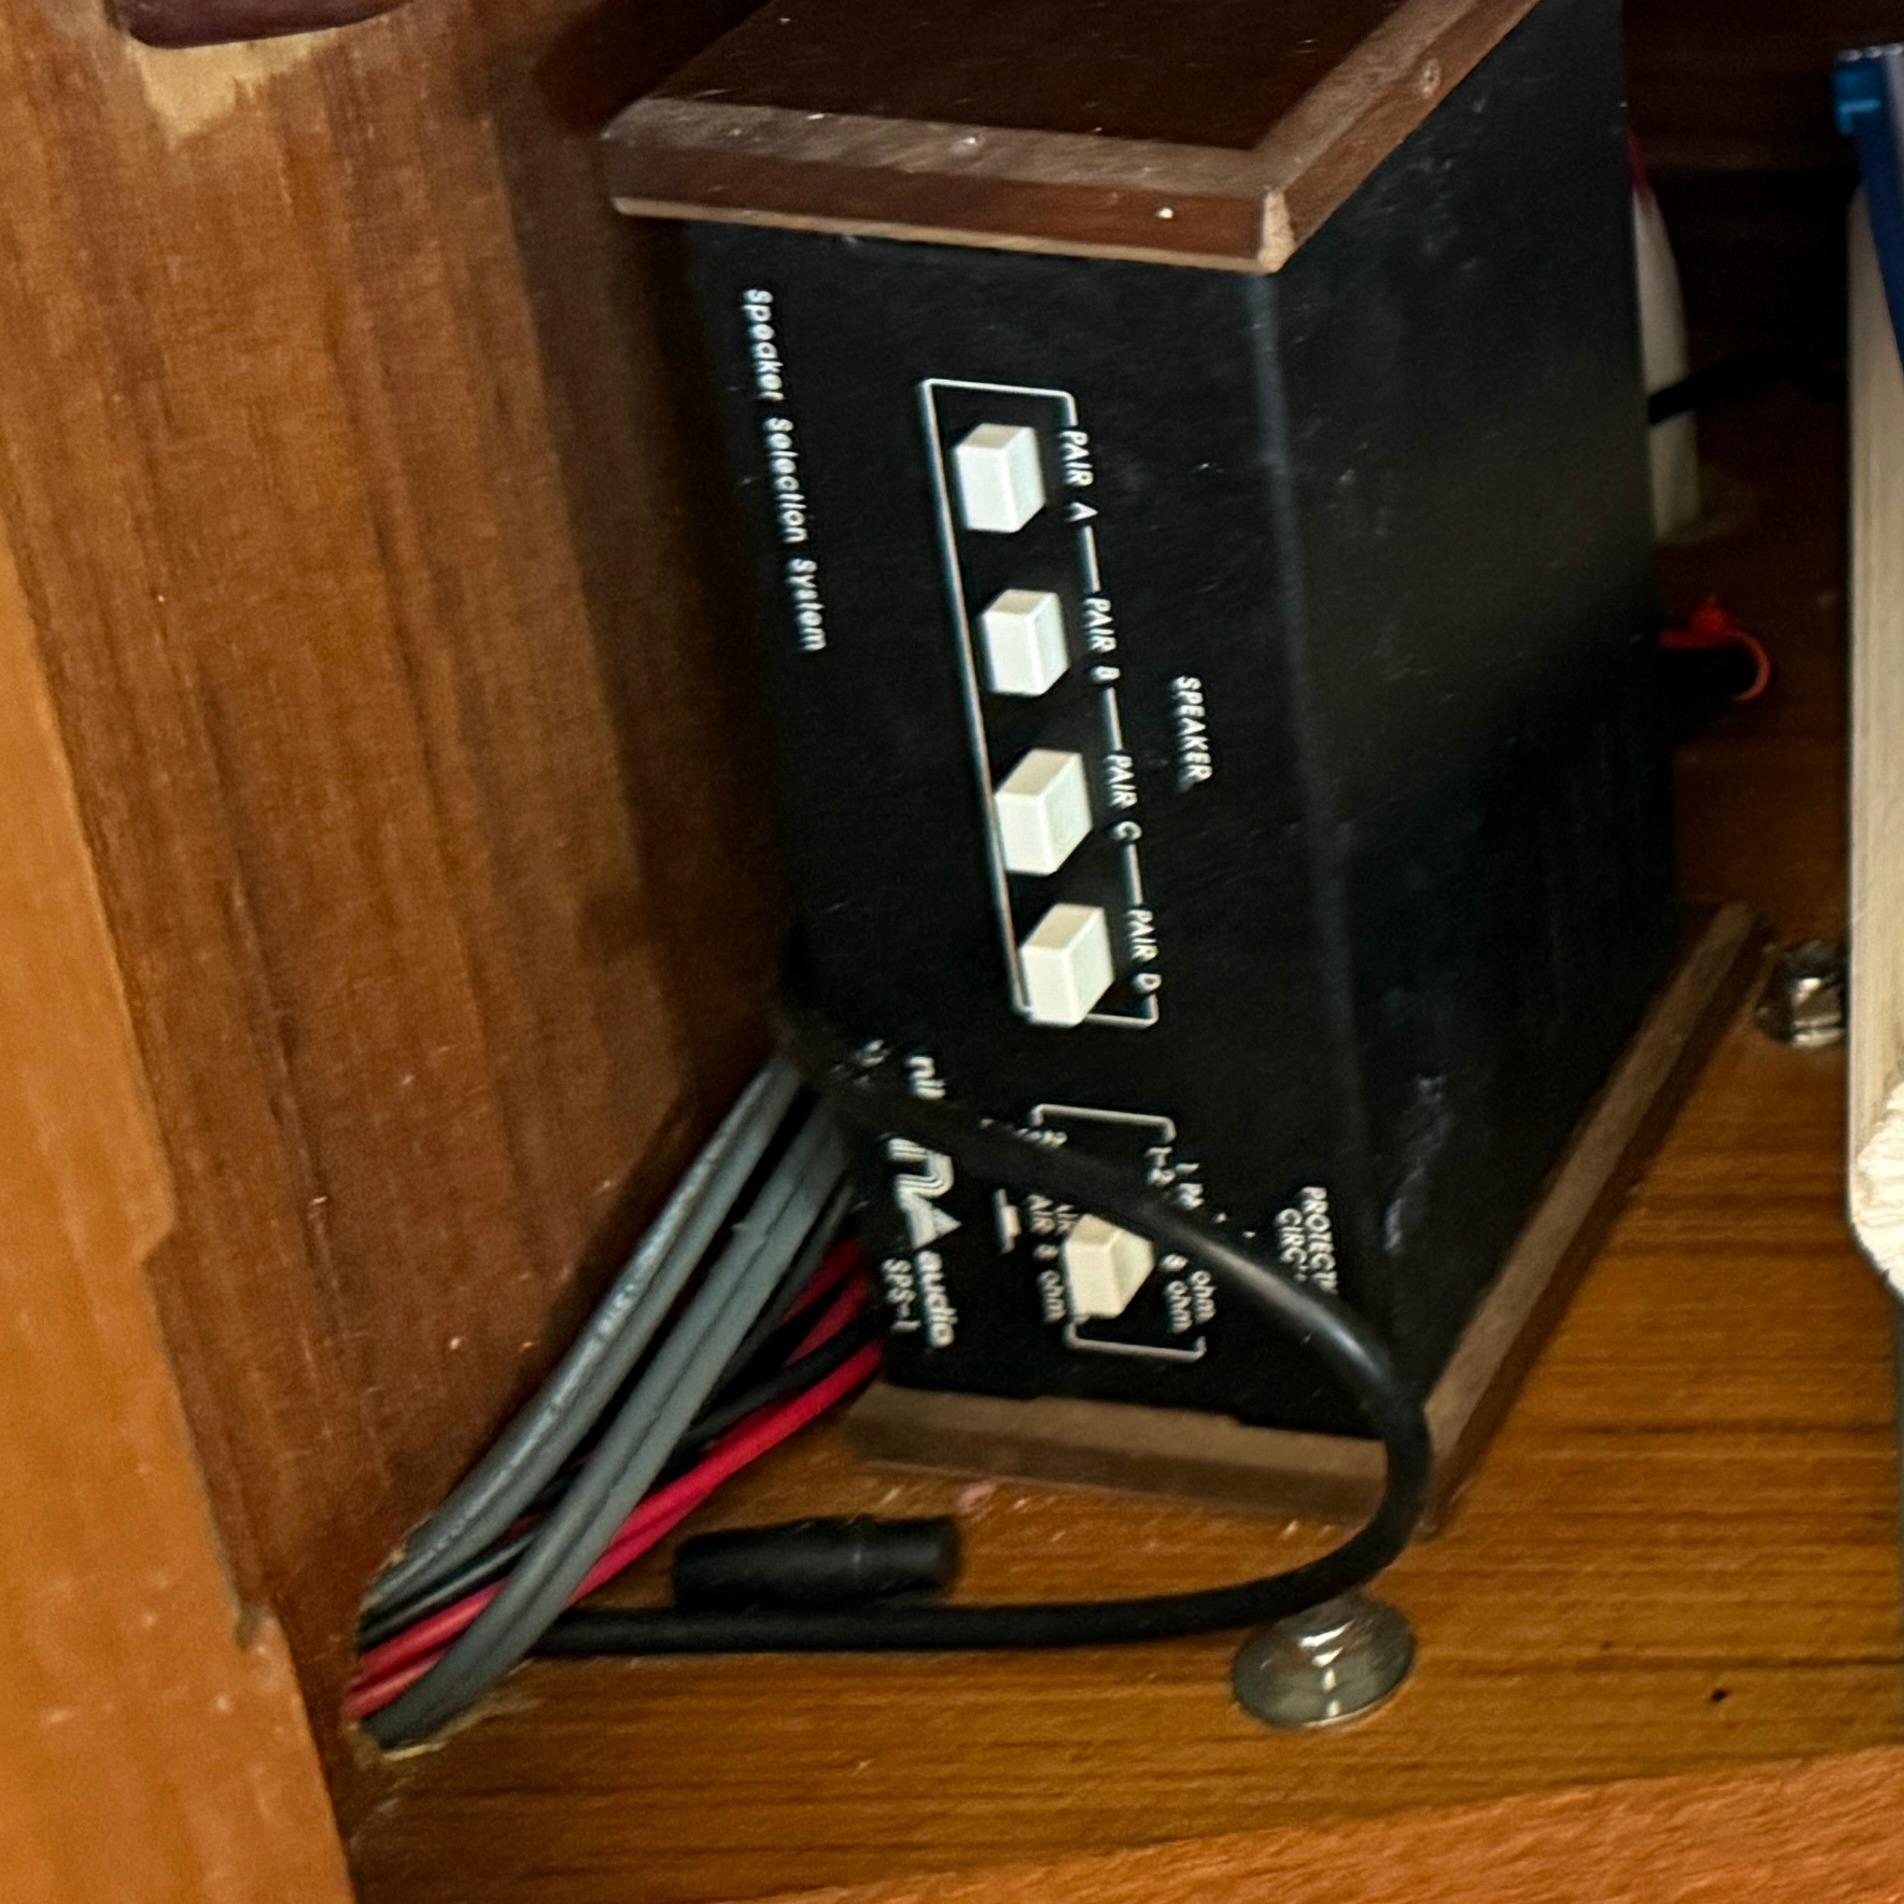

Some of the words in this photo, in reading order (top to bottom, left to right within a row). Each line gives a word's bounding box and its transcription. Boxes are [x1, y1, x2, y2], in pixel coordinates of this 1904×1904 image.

[741, 288, 787, 401] Speaker
[763, 417, 809, 543] Selection
[1062, 429, 1094, 485] PAIR
[1070, 502, 1101, 523] A
[784, 558, 827, 651] System
[1085, 597, 1118, 650] PAIR
[1094, 665, 1121, 682] B
[1171, 676, 1213, 783] SPEAKER
[1106, 753, 1138, 807] PAIR
[1112, 820, 1142, 843] C
[1129, 908, 1159, 960] PAIR
[1134, 972, 1163, 993] D
[1026, 1194, 1055, 1234] AIR
[880, 1258, 920, 1333] SPS-1
[916, 1251, 957, 1348] audio
[1036, 1270, 1065, 1322] ohm
